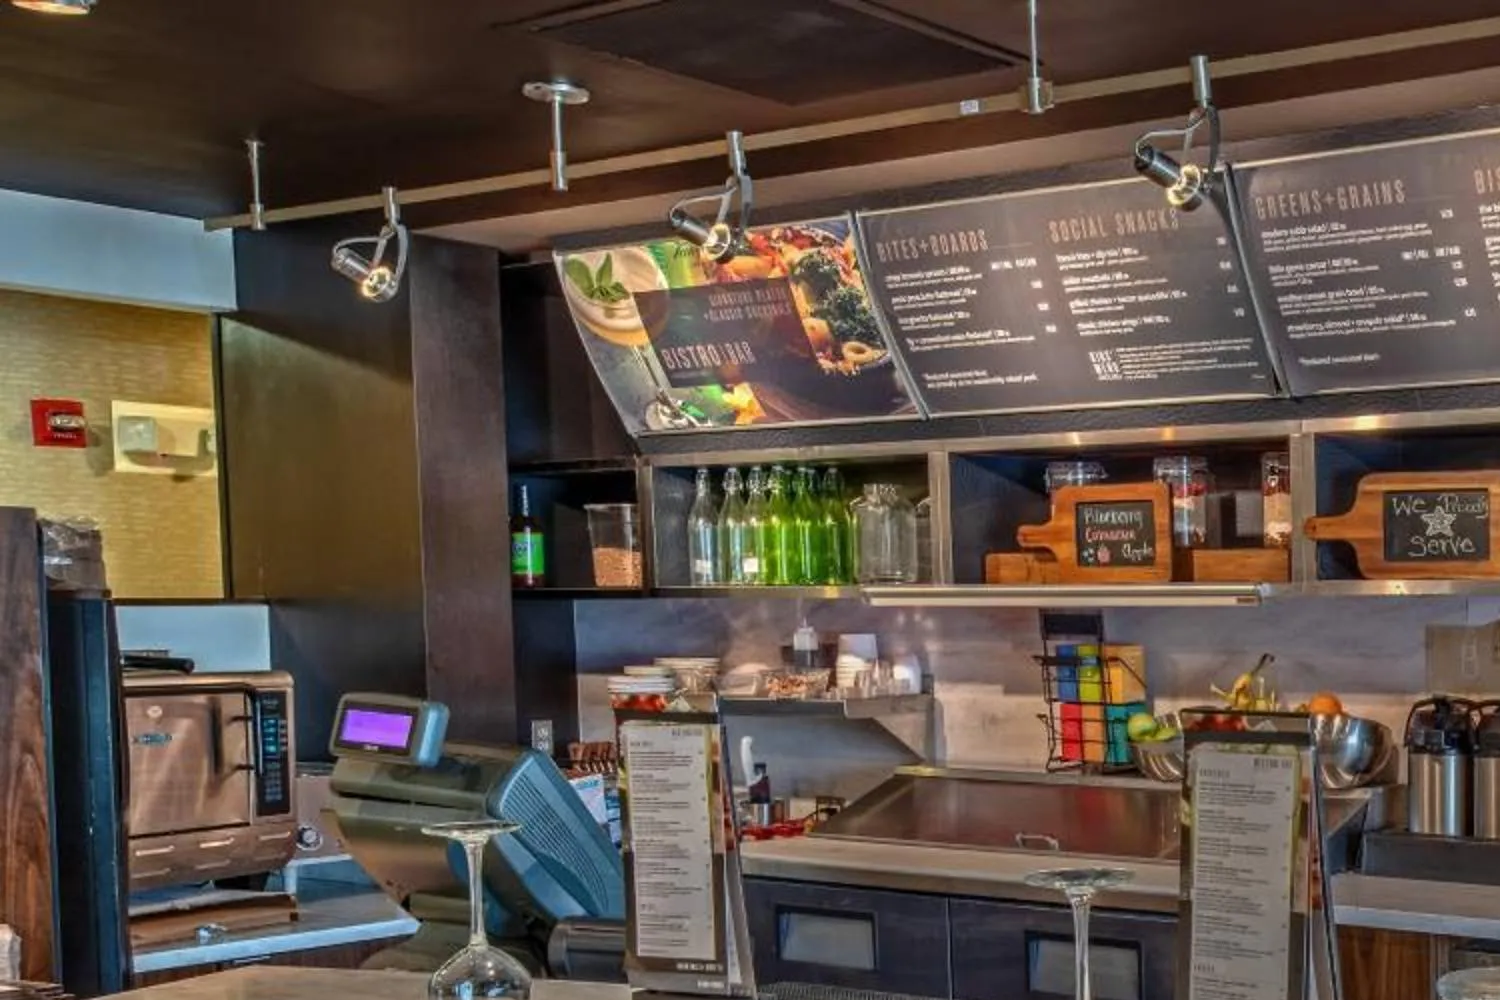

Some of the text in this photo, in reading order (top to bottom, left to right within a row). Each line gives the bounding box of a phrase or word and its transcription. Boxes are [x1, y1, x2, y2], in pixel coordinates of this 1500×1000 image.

[1255, 179, 1406, 220] GREENS+GRAINS
[1050, 208, 1179, 243] SOCIAL SNACKS
[876, 229, 989, 263] BITES+BOARDS
[661, 343, 721, 369] BISTRO
[1392, 495, 1428, 517] We
[1407, 535, 1476, 557] Serve
